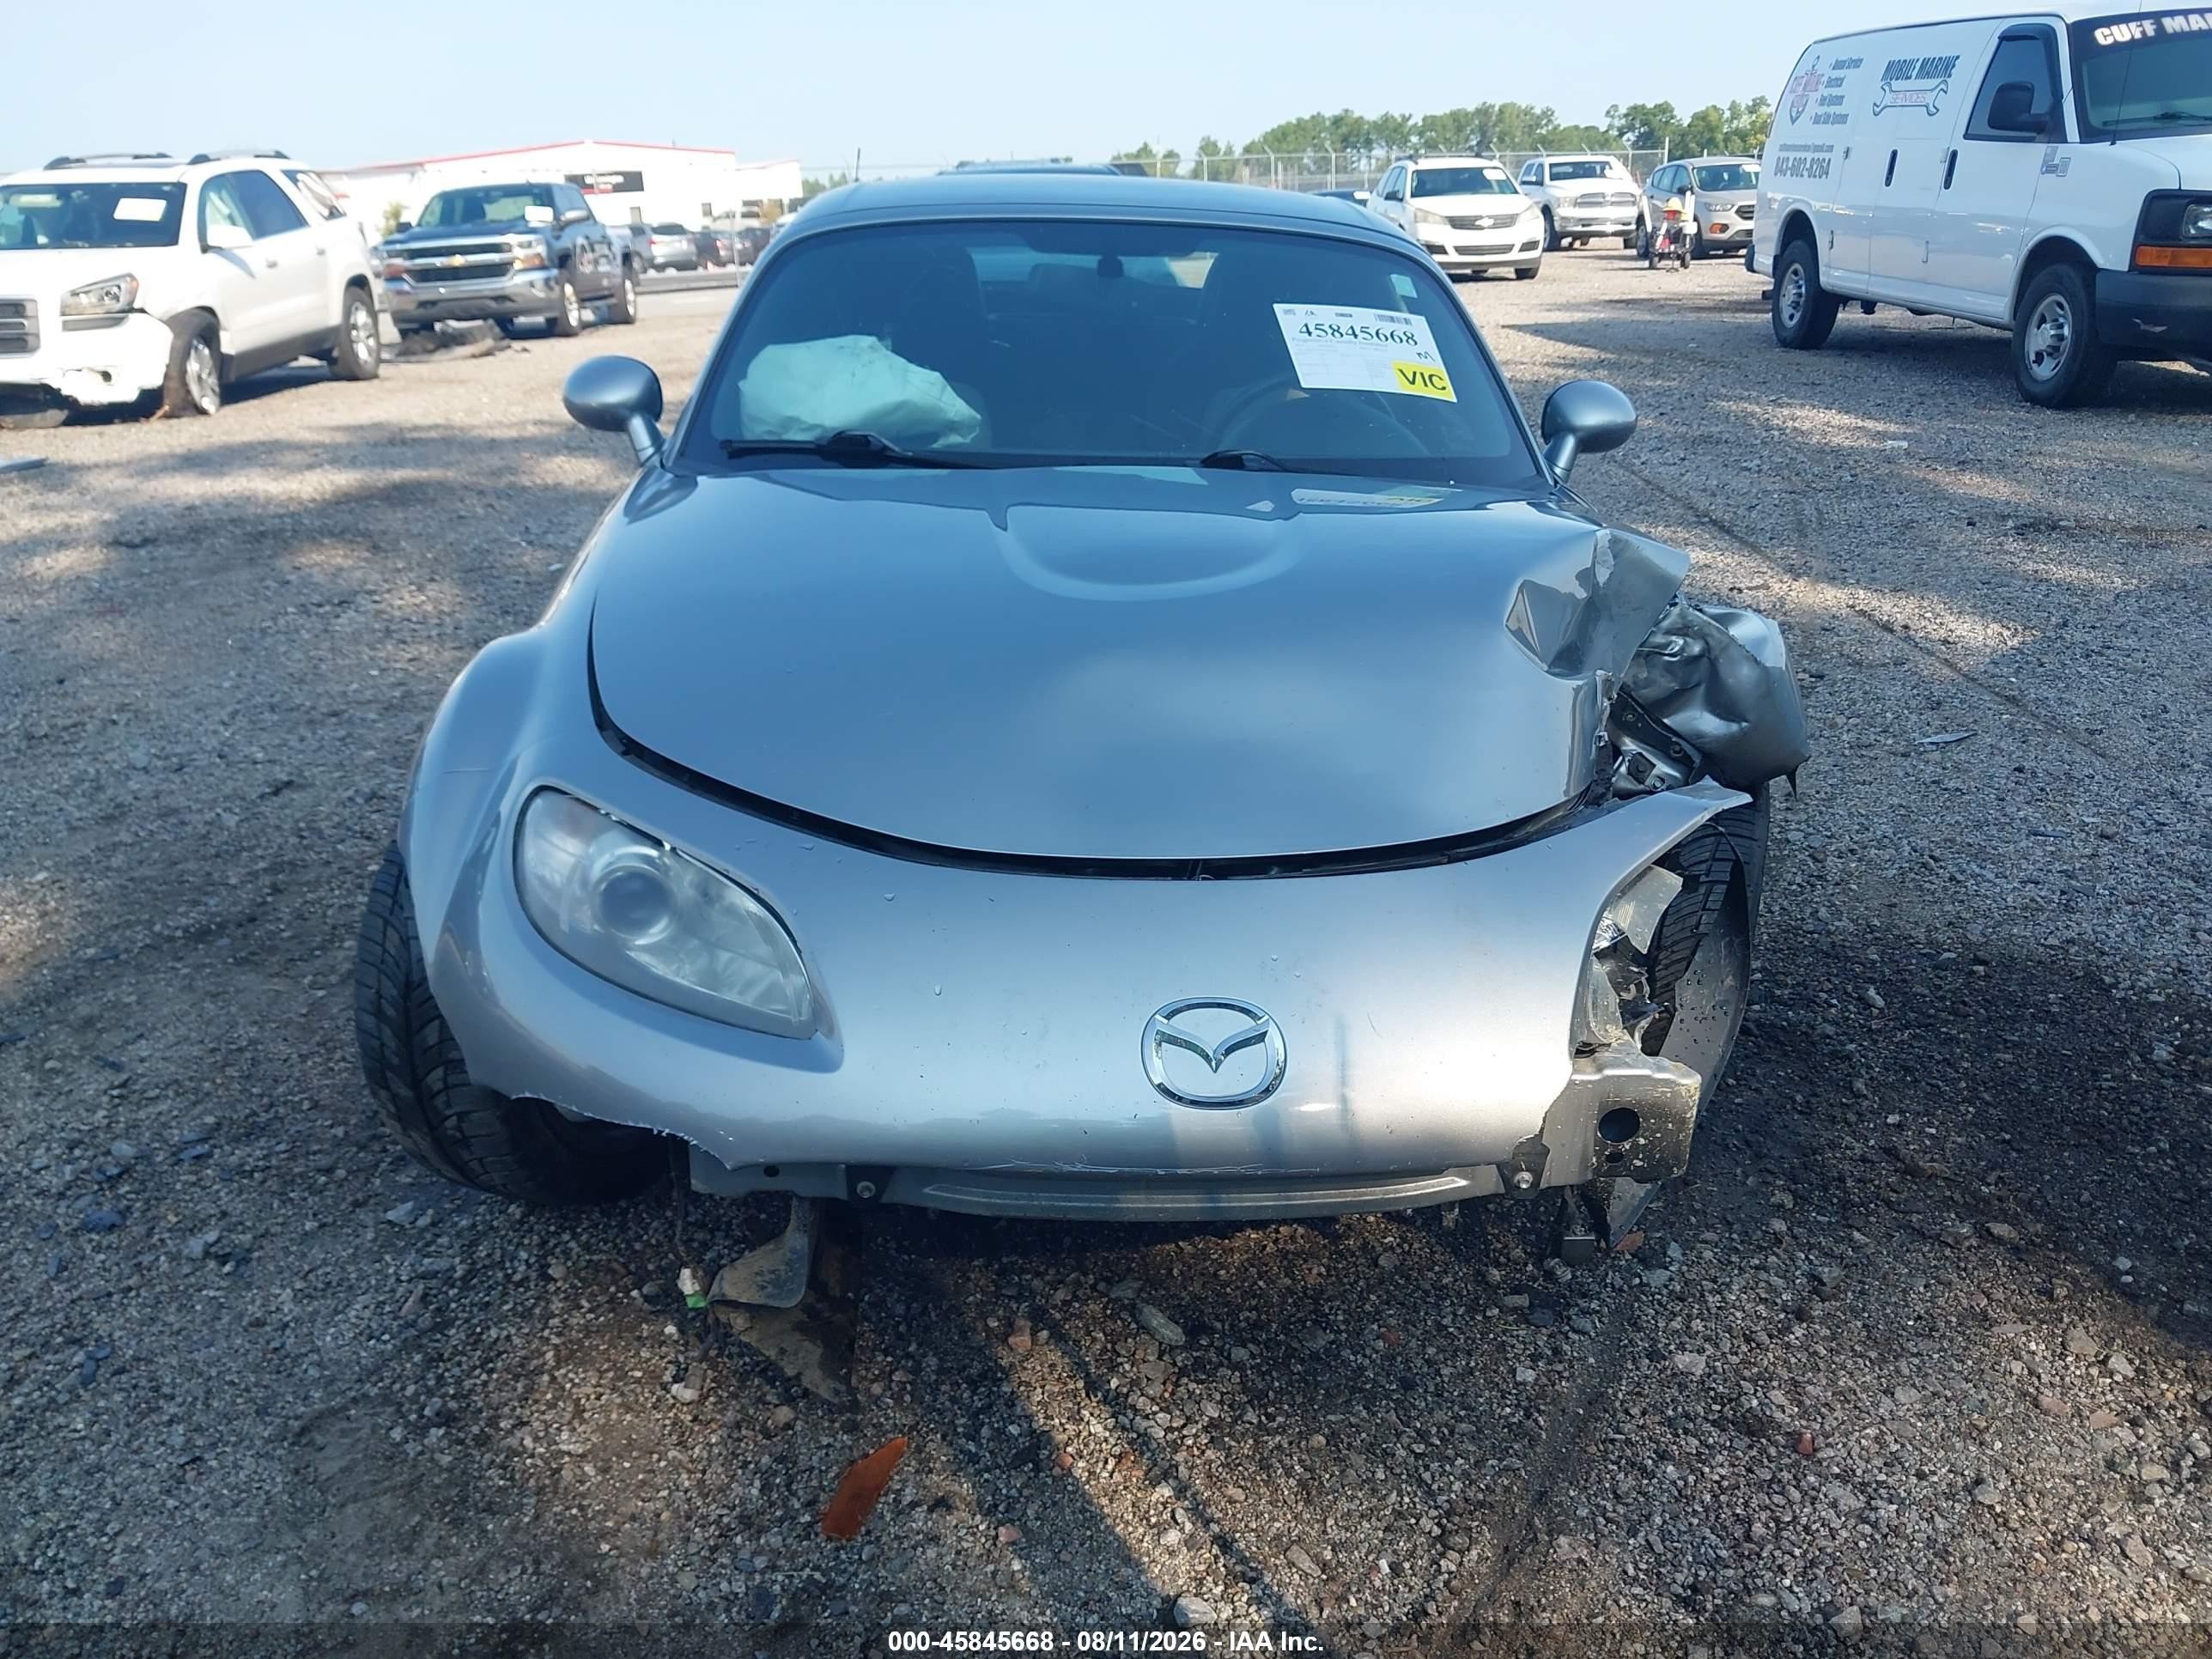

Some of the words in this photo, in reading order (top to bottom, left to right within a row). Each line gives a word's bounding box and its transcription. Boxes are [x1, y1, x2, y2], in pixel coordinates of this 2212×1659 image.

[2094, 19, 2157, 46] CUFF
[1881, 58, 1920, 82] MOBILE
[1914, 55, 1960, 80] MARINE
[1774, 155, 1832, 179] 843-602-8264
[1298, 322, 1418, 347] 45845668
[1397, 368, 1447, 391] VIC
